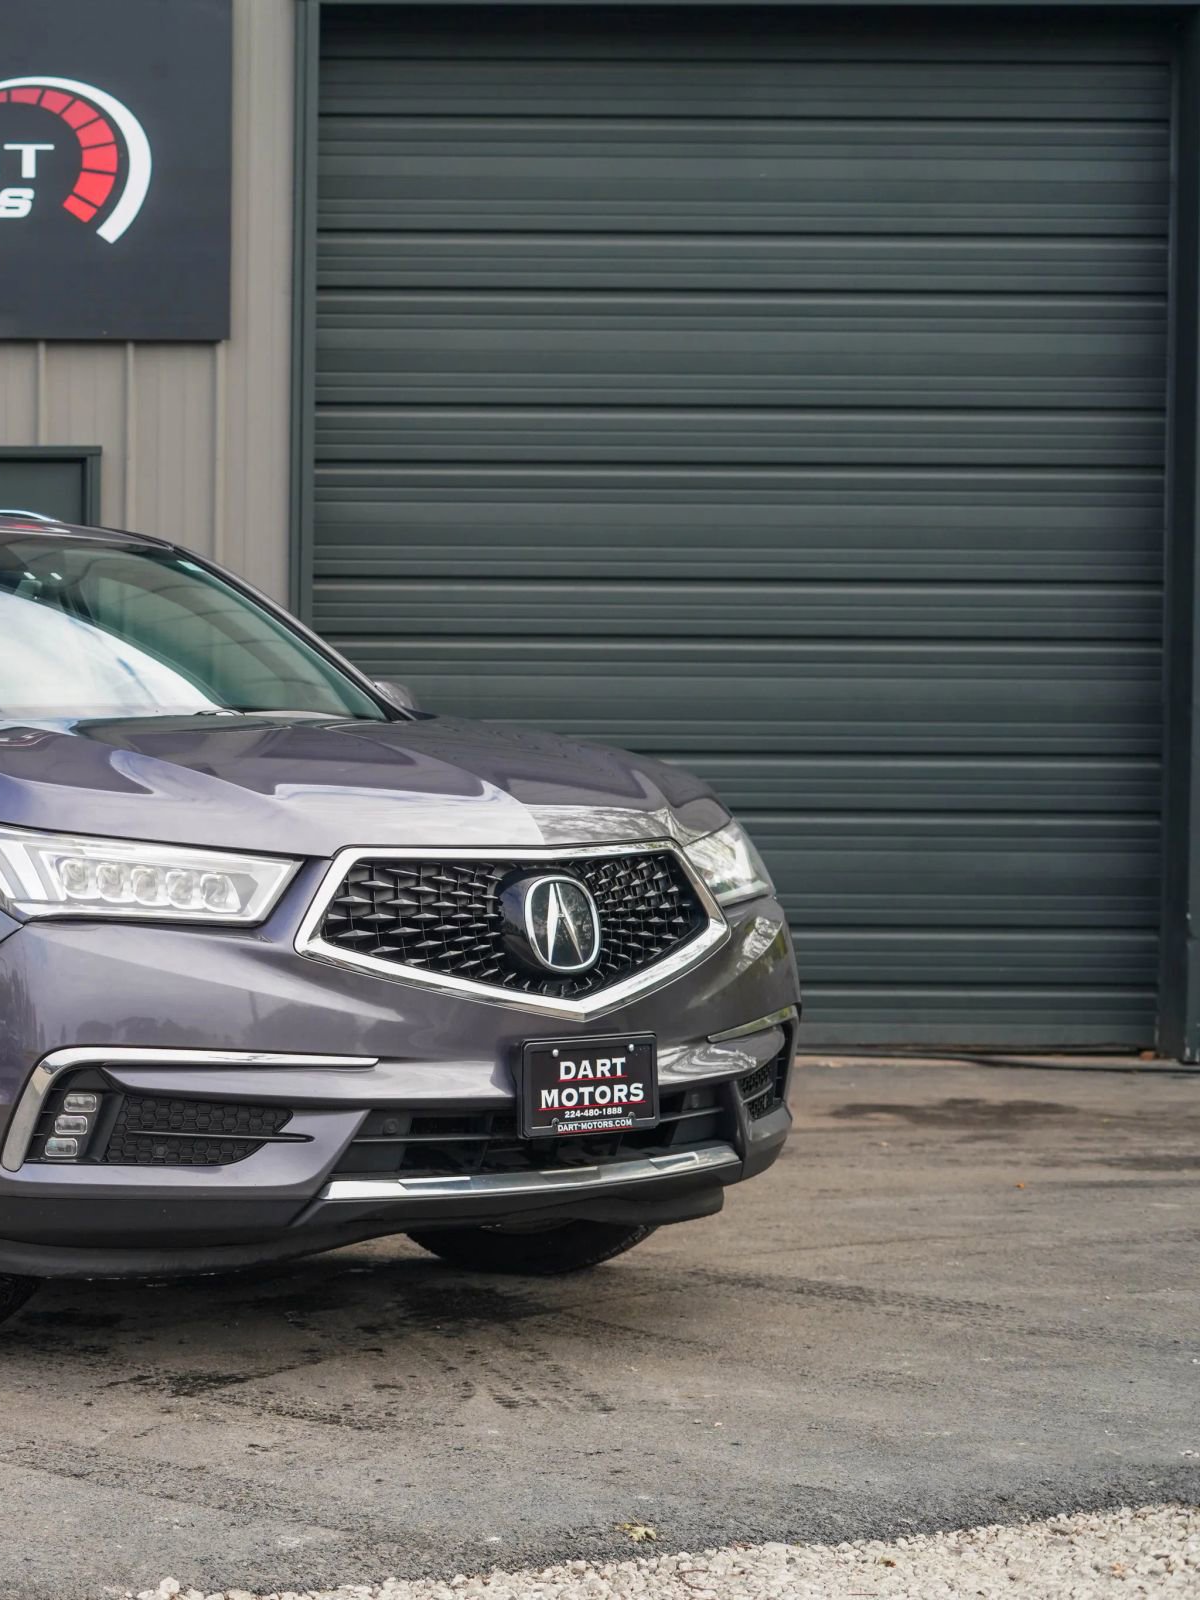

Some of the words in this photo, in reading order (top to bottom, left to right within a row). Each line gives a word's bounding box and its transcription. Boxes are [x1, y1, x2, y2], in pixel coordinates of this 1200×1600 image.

[560, 1057, 626, 1080] DART
[540, 1083, 644, 1109] MOTORS
[564, 1106, 623, 1119] 224-480-1888
[557, 1118, 633, 1132] DART-MOTORS.COM
